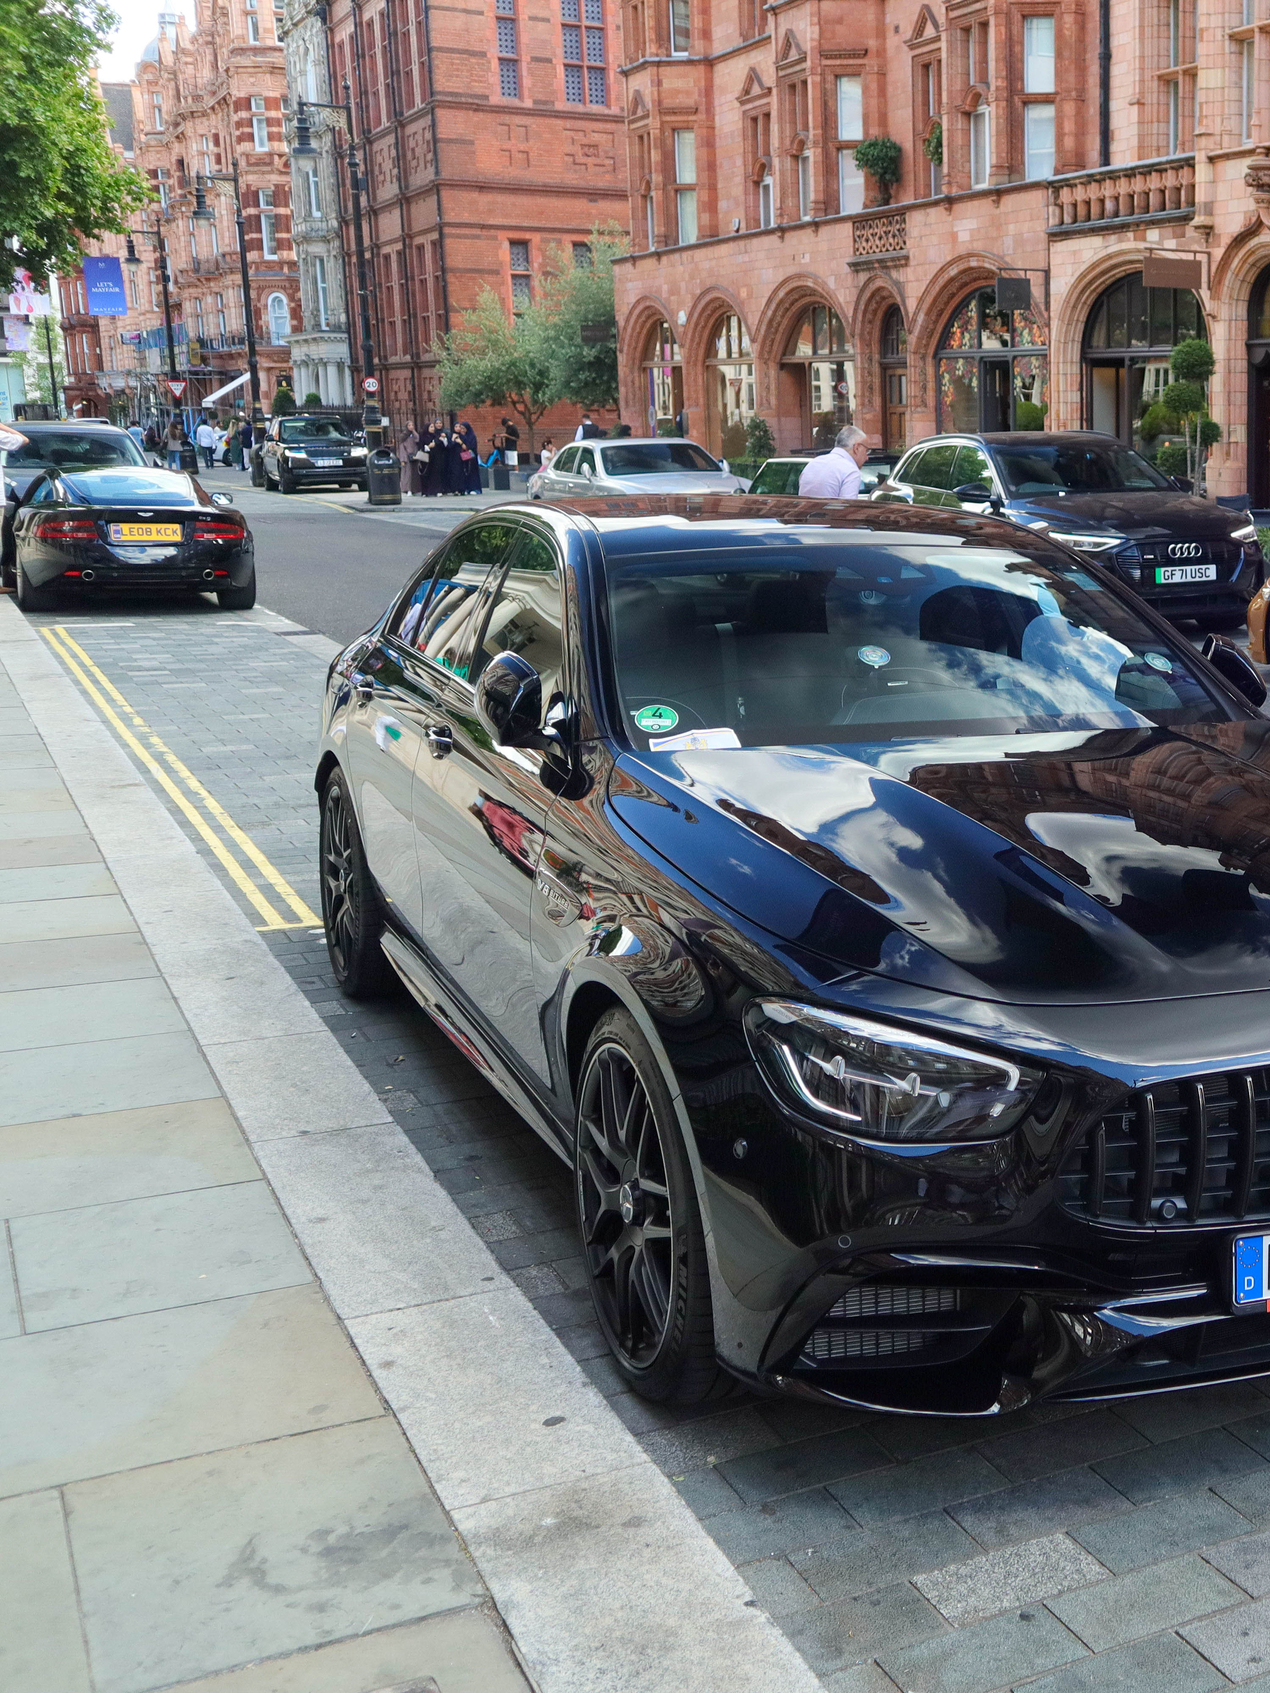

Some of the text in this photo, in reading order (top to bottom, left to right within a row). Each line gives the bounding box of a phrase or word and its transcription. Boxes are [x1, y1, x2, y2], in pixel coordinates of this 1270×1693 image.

[120, 527, 153, 536] LE08
[156, 527, 180, 537] KCK
[1163, 567, 1211, 581] GF71 USC
[652, 707, 663, 719] 4
[537, 878, 550, 896] V8
[1244, 1276, 1255, 1290] D
